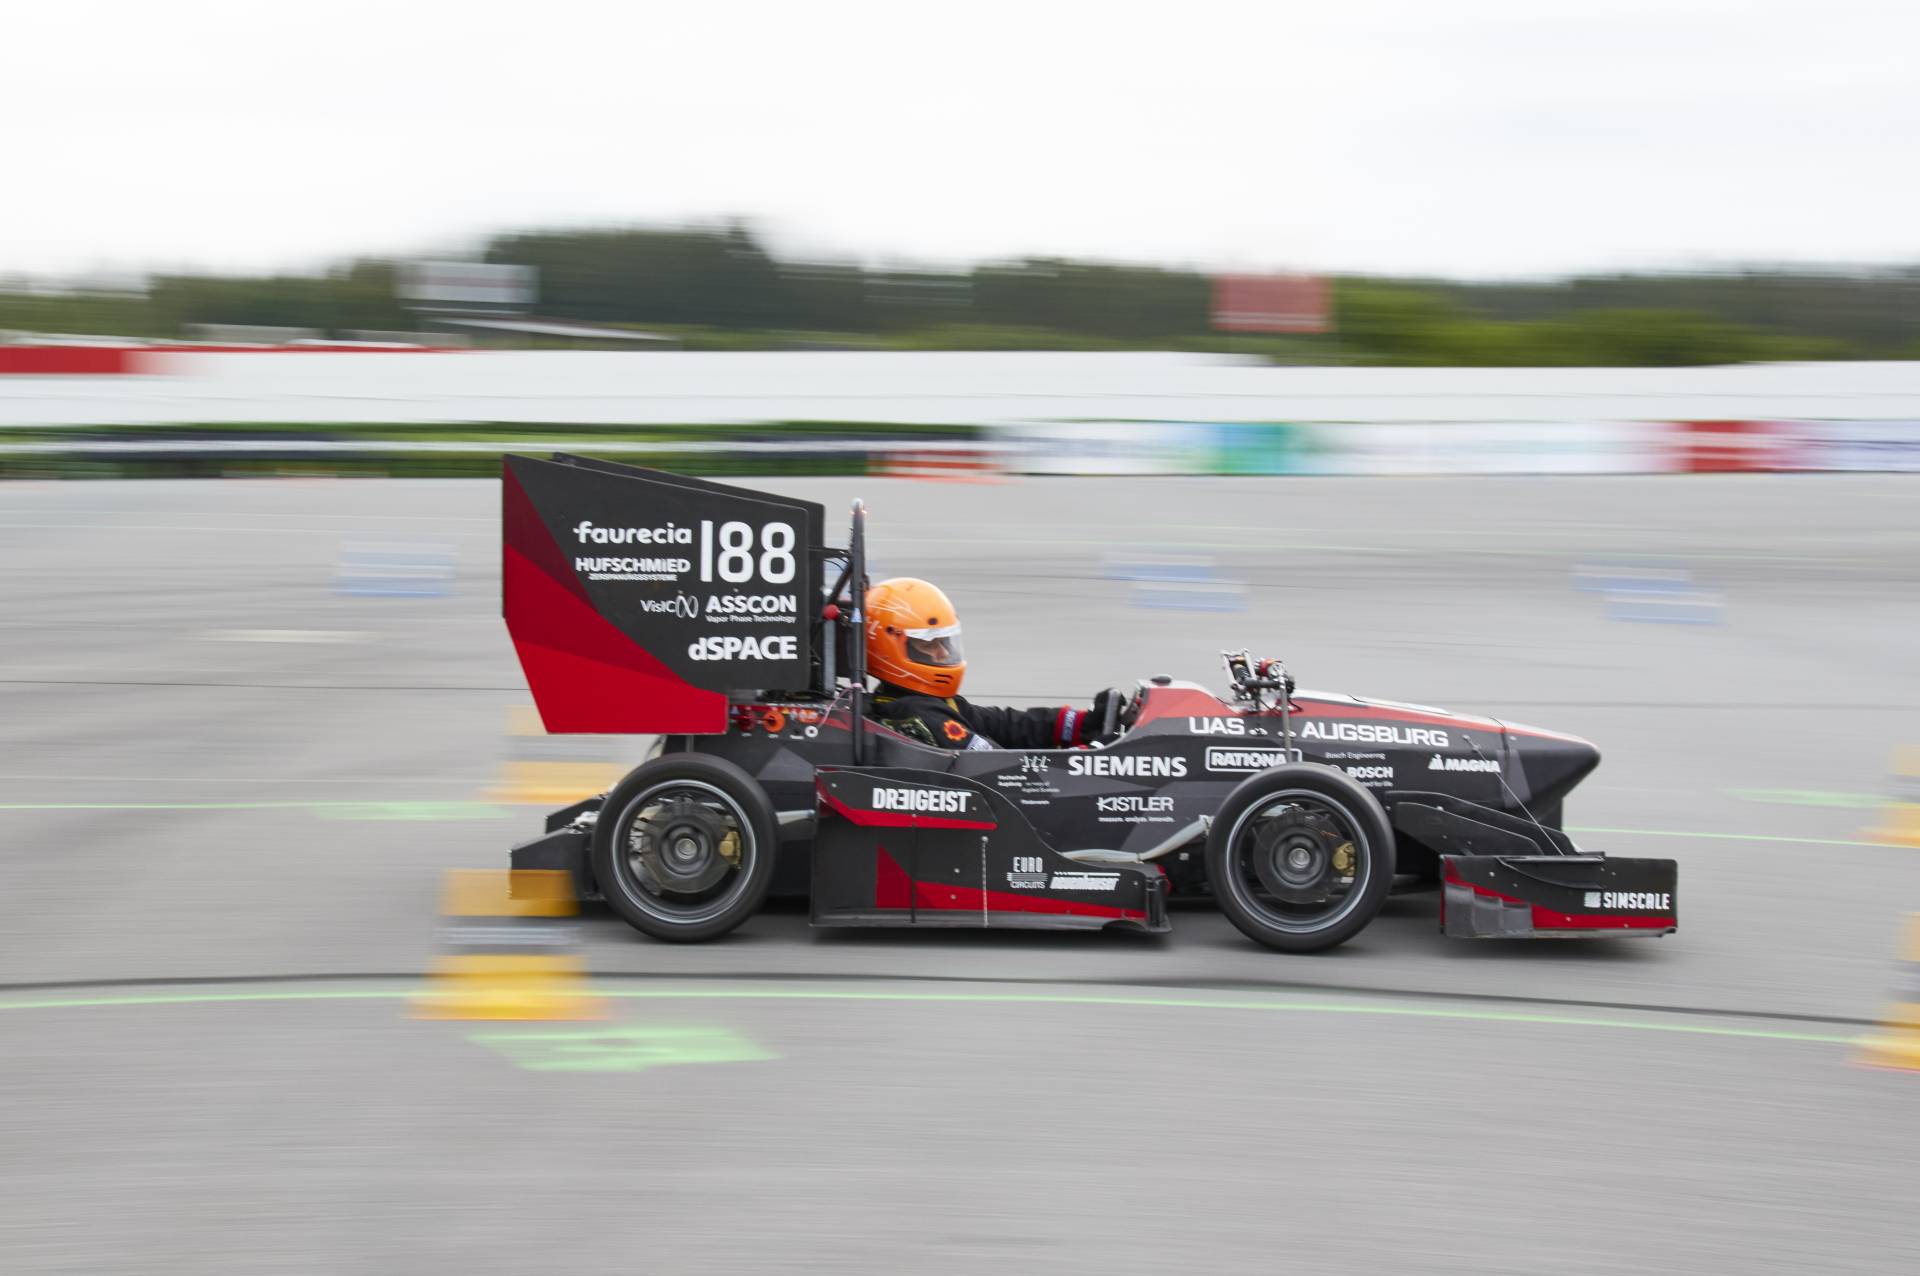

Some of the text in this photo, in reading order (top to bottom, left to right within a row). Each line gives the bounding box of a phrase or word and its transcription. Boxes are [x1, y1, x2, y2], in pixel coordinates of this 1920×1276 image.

[573, 520, 692, 544] faurecia
[575, 557, 691, 572] HUFSCHMIED
[705, 595, 797, 613] ASSCON
[730, 615, 752, 623] Phase
[754, 615, 797, 624] Technology
[688, 635, 798, 661] dSPACE
[1188, 716, 1449, 747] UAS AUGSBURG
[1068, 755, 1188, 778] SIEMENS
[1210, 751, 1288, 768] RATIONA
[1445, 758, 1501, 773] MAGNA
[1346, 766, 1394, 778] BOSCH
[1096, 796, 1175, 812] KISTLER
[1013, 856, 1043, 873] EURO
[1603, 892, 1671, 910] SINSCALE
